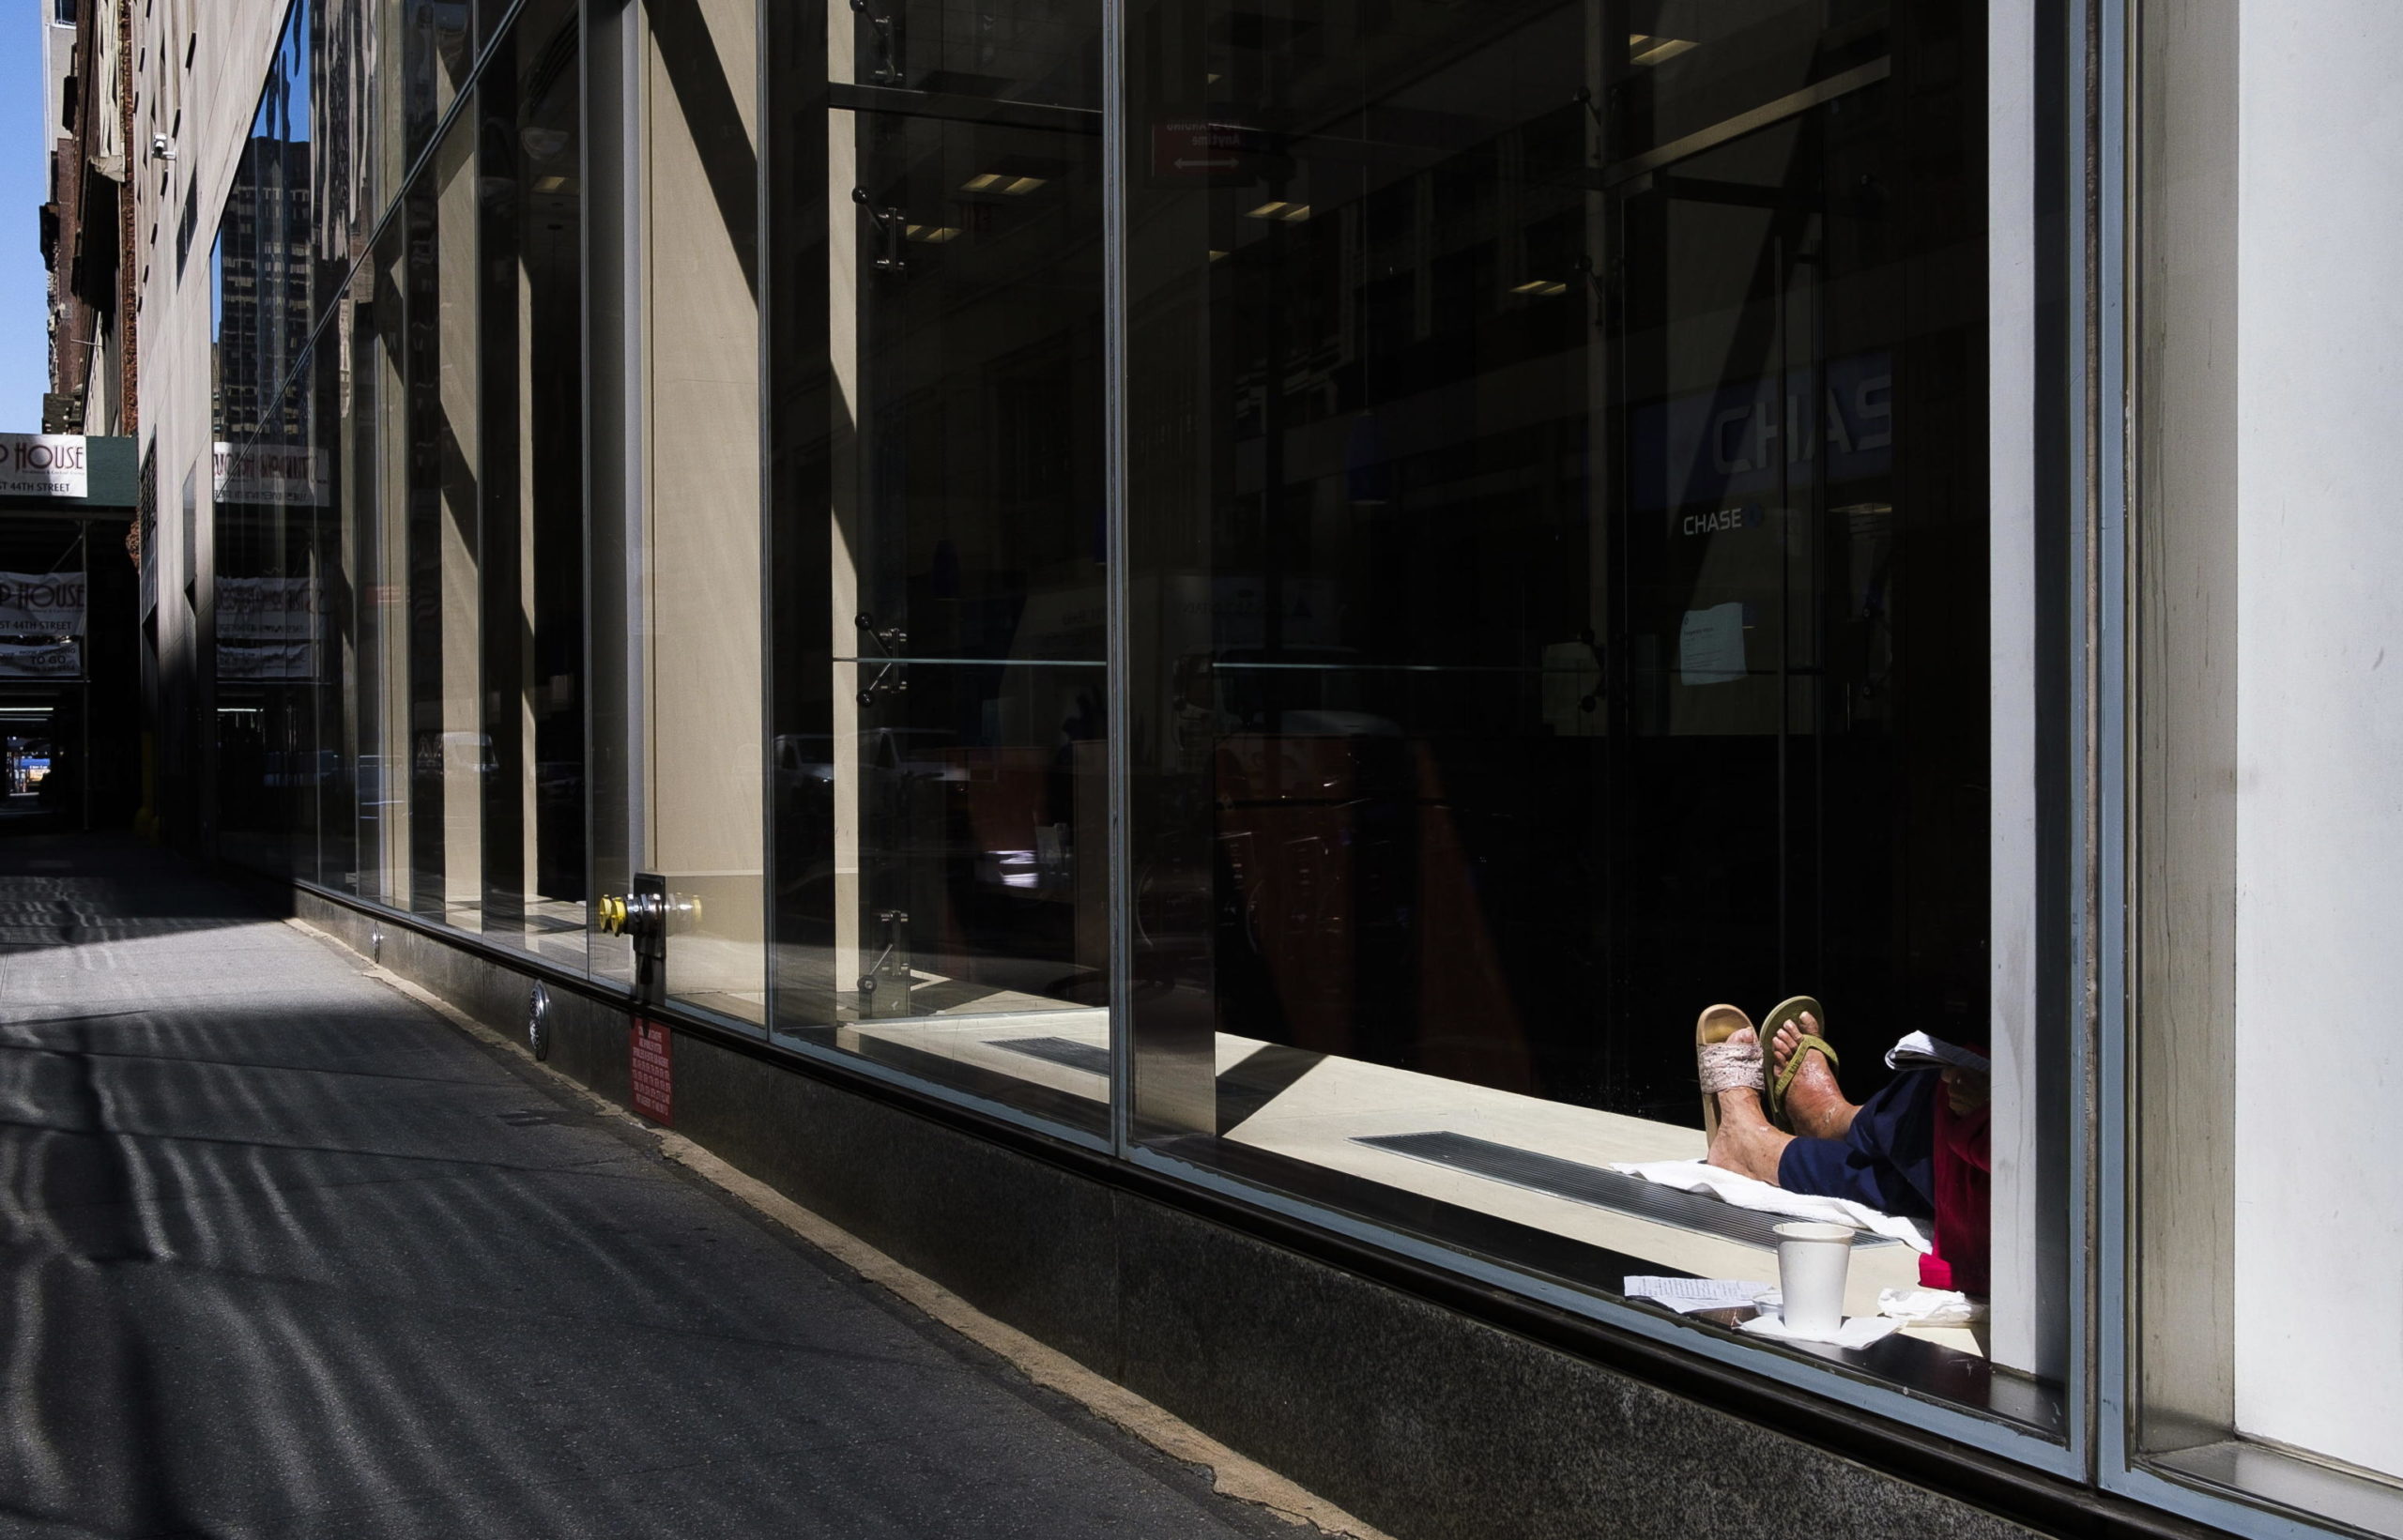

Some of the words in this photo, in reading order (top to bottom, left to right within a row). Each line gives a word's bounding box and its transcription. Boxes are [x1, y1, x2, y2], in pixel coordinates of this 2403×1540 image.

[15, 441, 84, 473] HOUSE
[10, 481, 35, 492] 44TH
[37, 481, 70, 493] STREET
[1683, 507, 1743, 536] CHASE
[17, 583, 84, 610] HOUSE
[13, 620, 37, 630] 44TH
[38, 620, 72, 631] STREET
